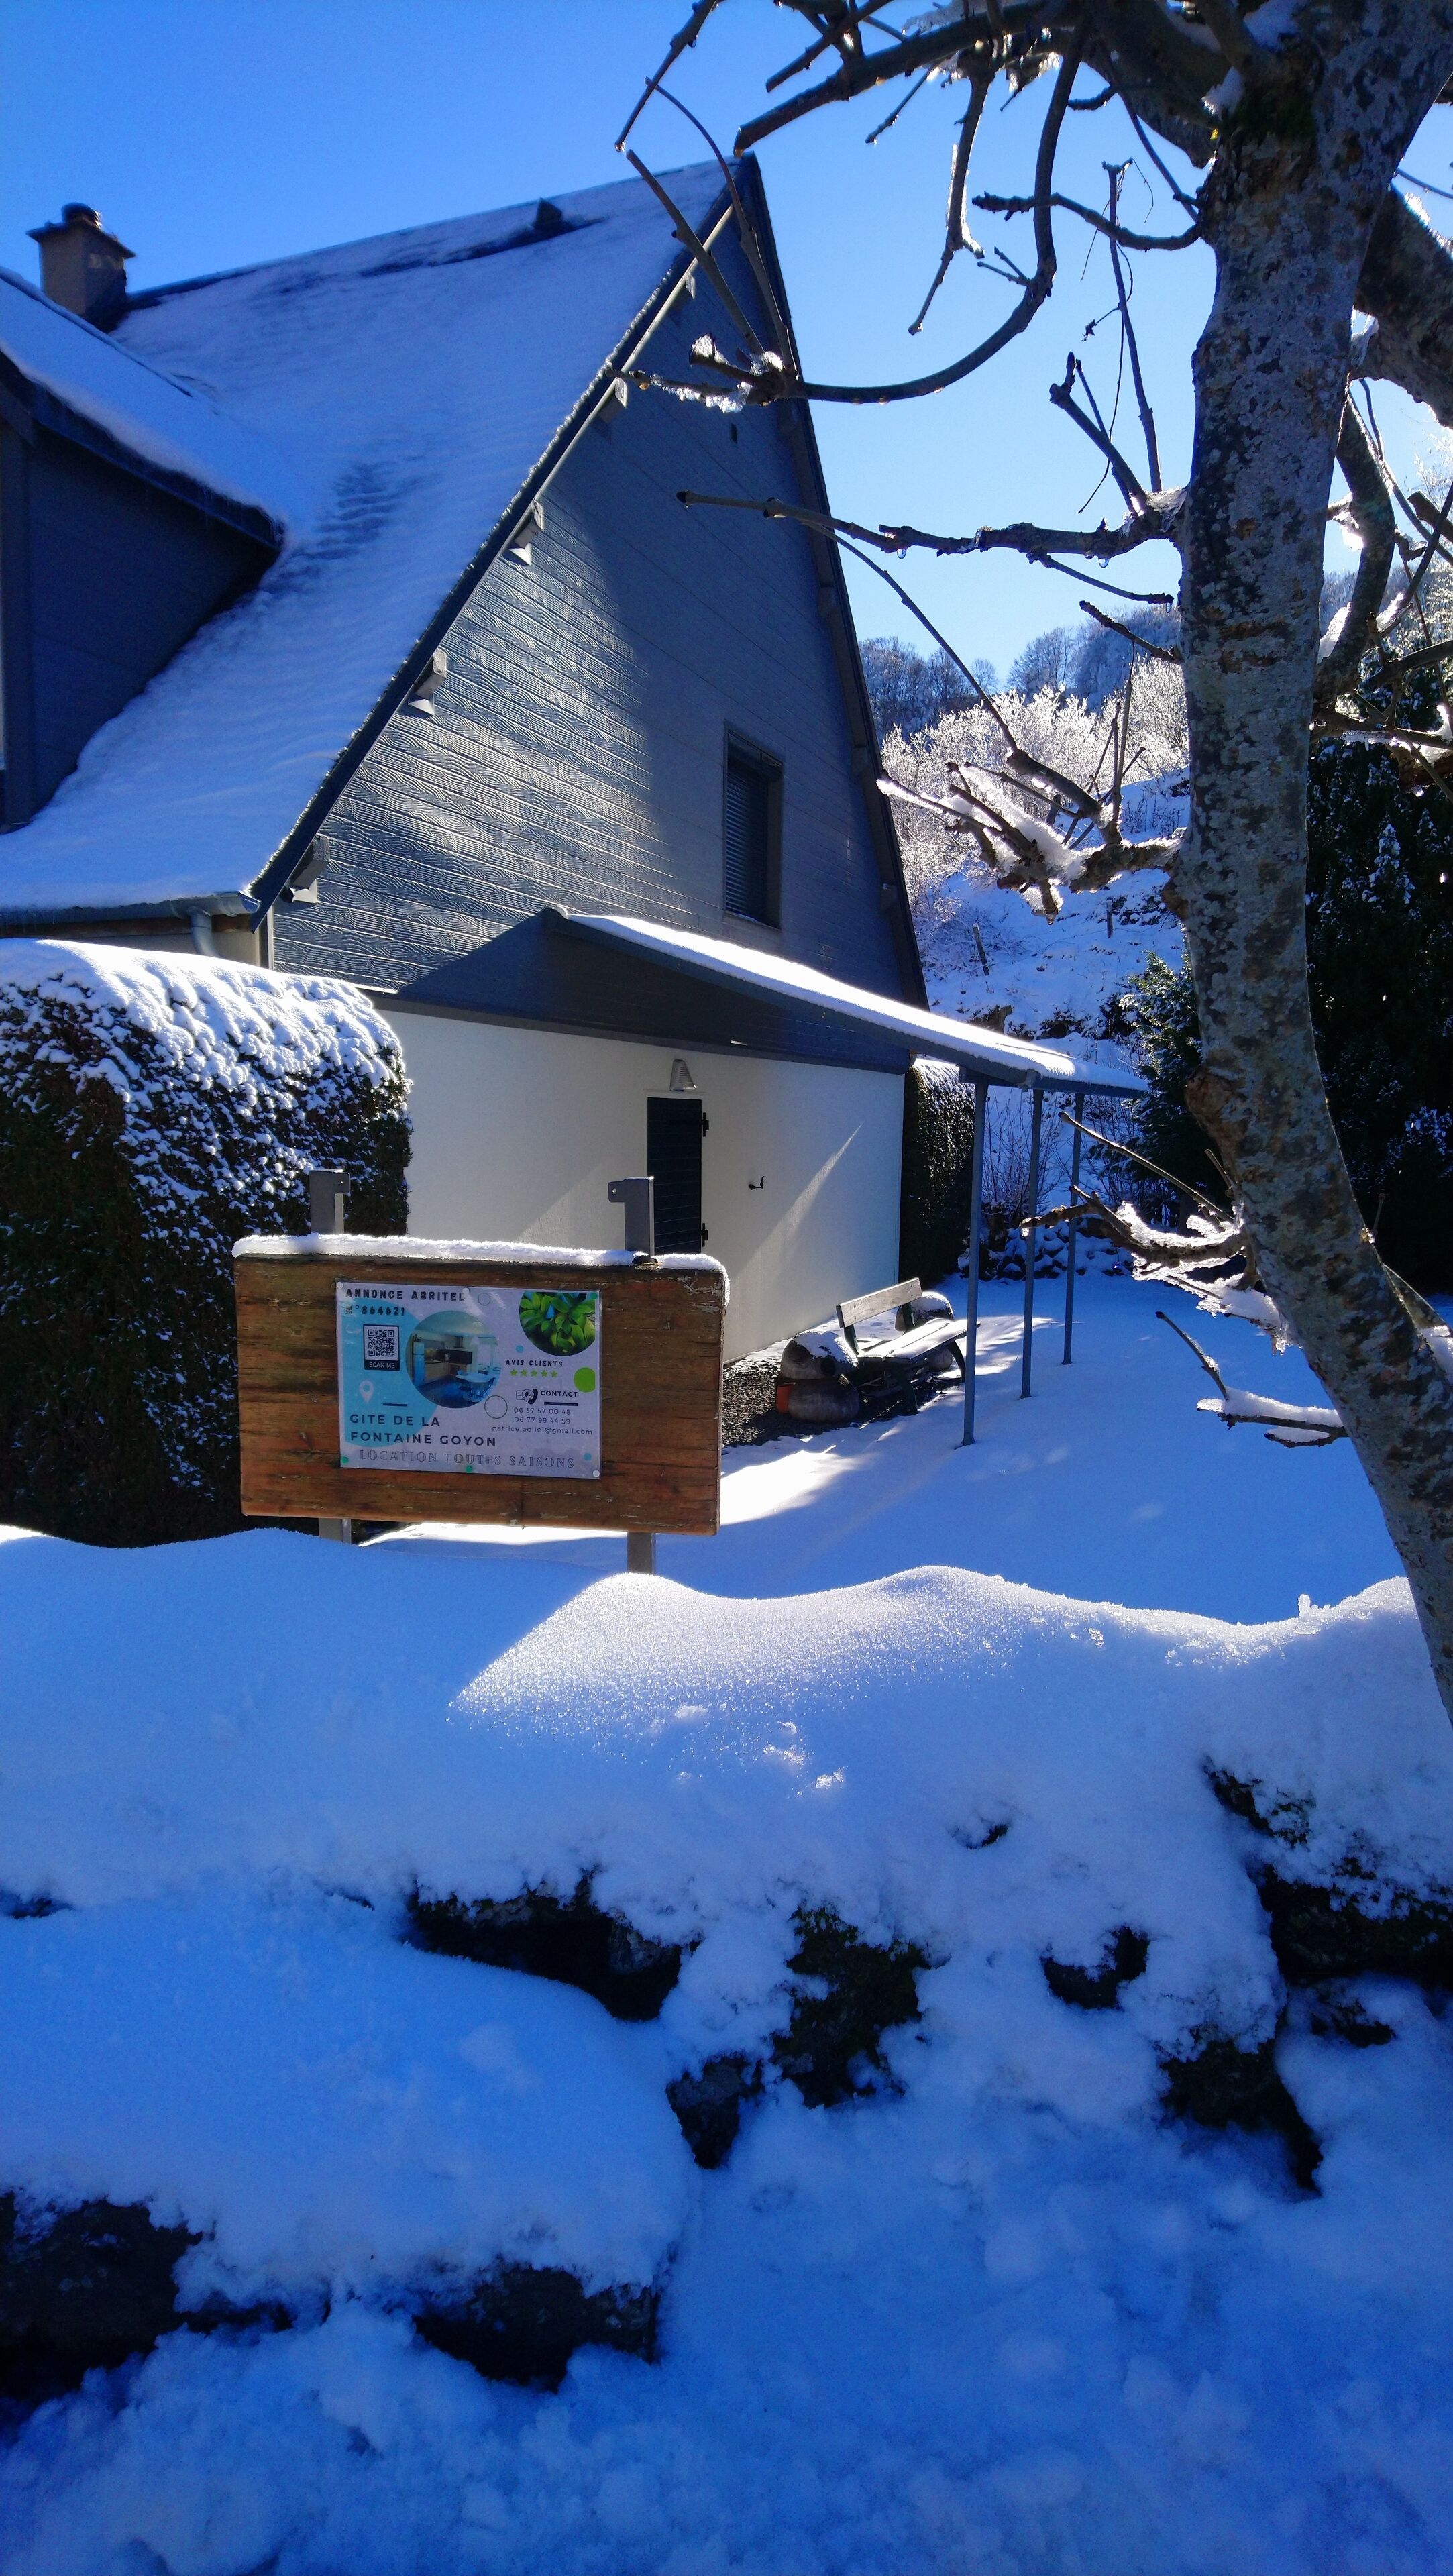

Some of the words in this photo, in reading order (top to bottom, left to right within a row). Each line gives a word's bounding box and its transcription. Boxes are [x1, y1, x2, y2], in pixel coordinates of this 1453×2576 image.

[345, 1288, 403, 1299] ANNONCE
[349, 1414, 386, 1425] GITE
[393, 1415, 414, 1426] DE
[421, 1417, 441, 1427] LA
[350, 1432, 432, 1444] FONTAINE
[439, 1435, 496, 1447] GOYON
[359, 1449, 437, 1462] LOCATION
[444, 1452, 502, 1466] TOUTES
[508, 1455, 575, 1468] SAISONS
